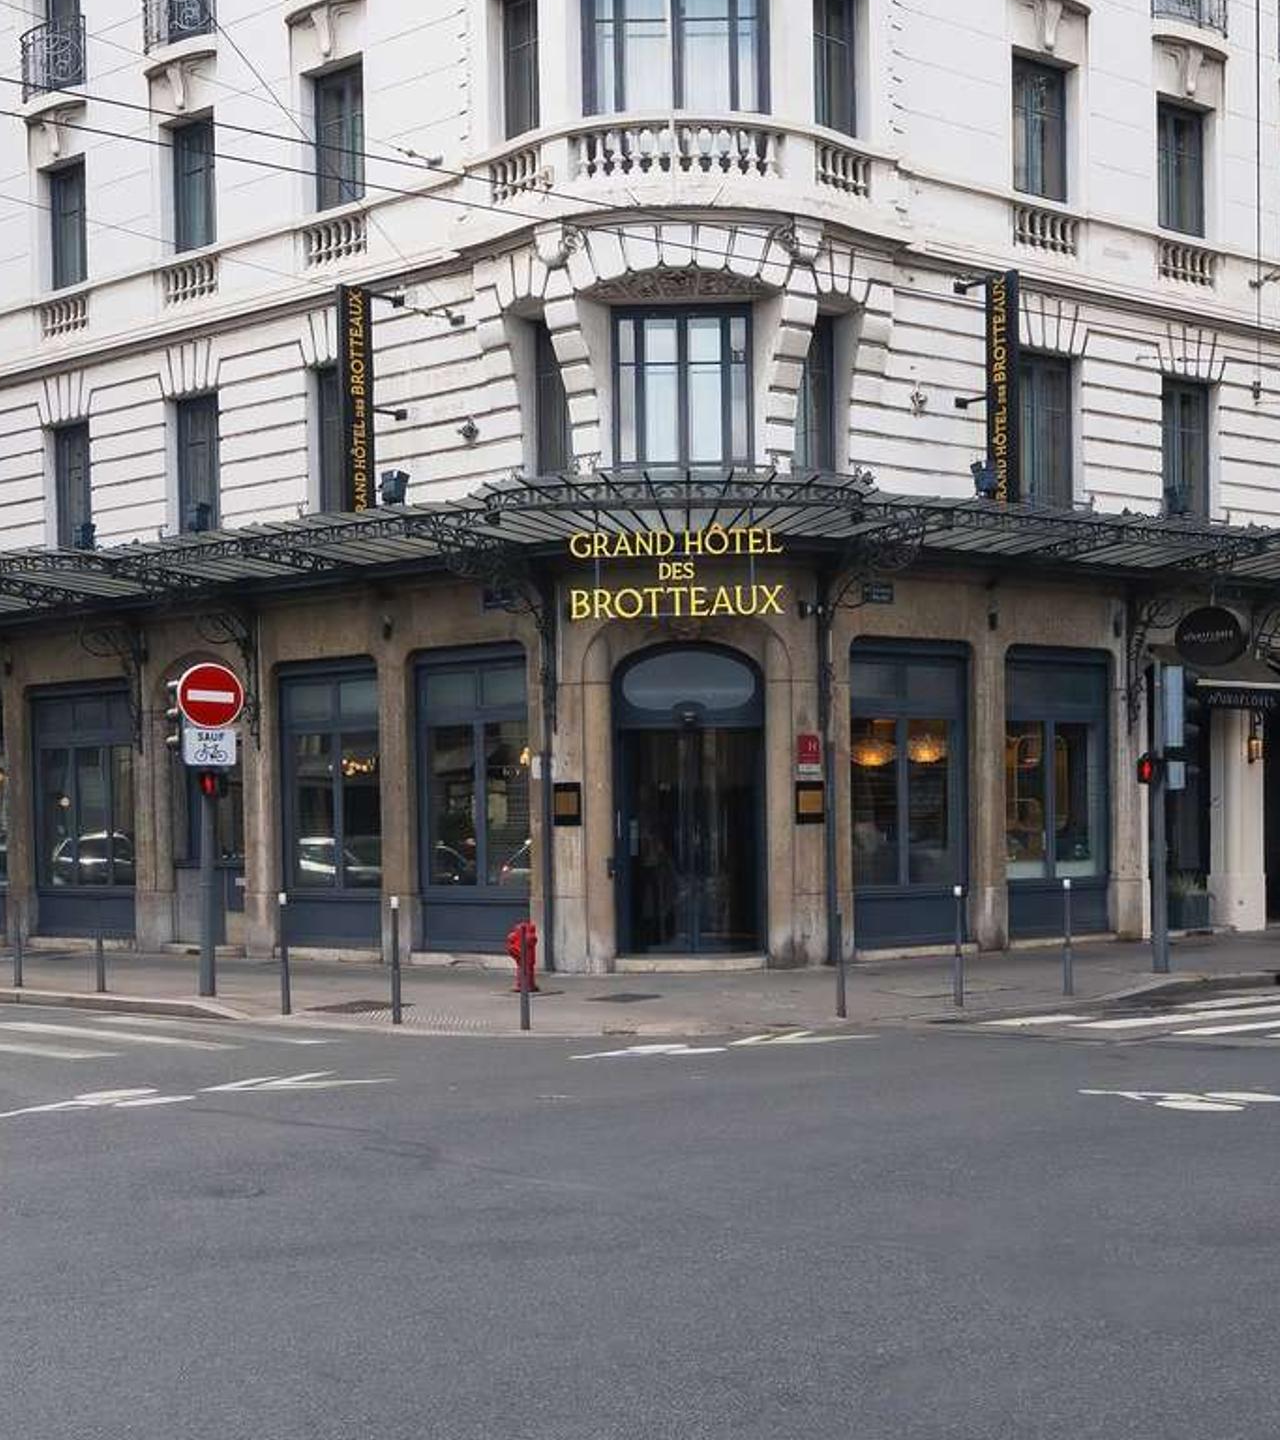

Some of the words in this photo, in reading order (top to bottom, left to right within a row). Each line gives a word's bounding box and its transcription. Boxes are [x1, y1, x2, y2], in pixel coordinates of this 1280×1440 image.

[348, 286, 366, 395] BROTTEAUX
[993, 276, 1007, 383] BROTTEAUX
[351, 423, 366, 470] HÔTEL
[993, 406, 1007, 457] HÔTEL
[355, 472, 368, 513] RAND
[996, 459, 1008, 502] RAND
[570, 530, 674, 558] GRAND
[685, 523, 784, 555] HÔTEL
[658, 562, 695, 580] DES
[570, 585, 785, 619] BROTTEAUX
[197, 731, 224, 741] SAUF
